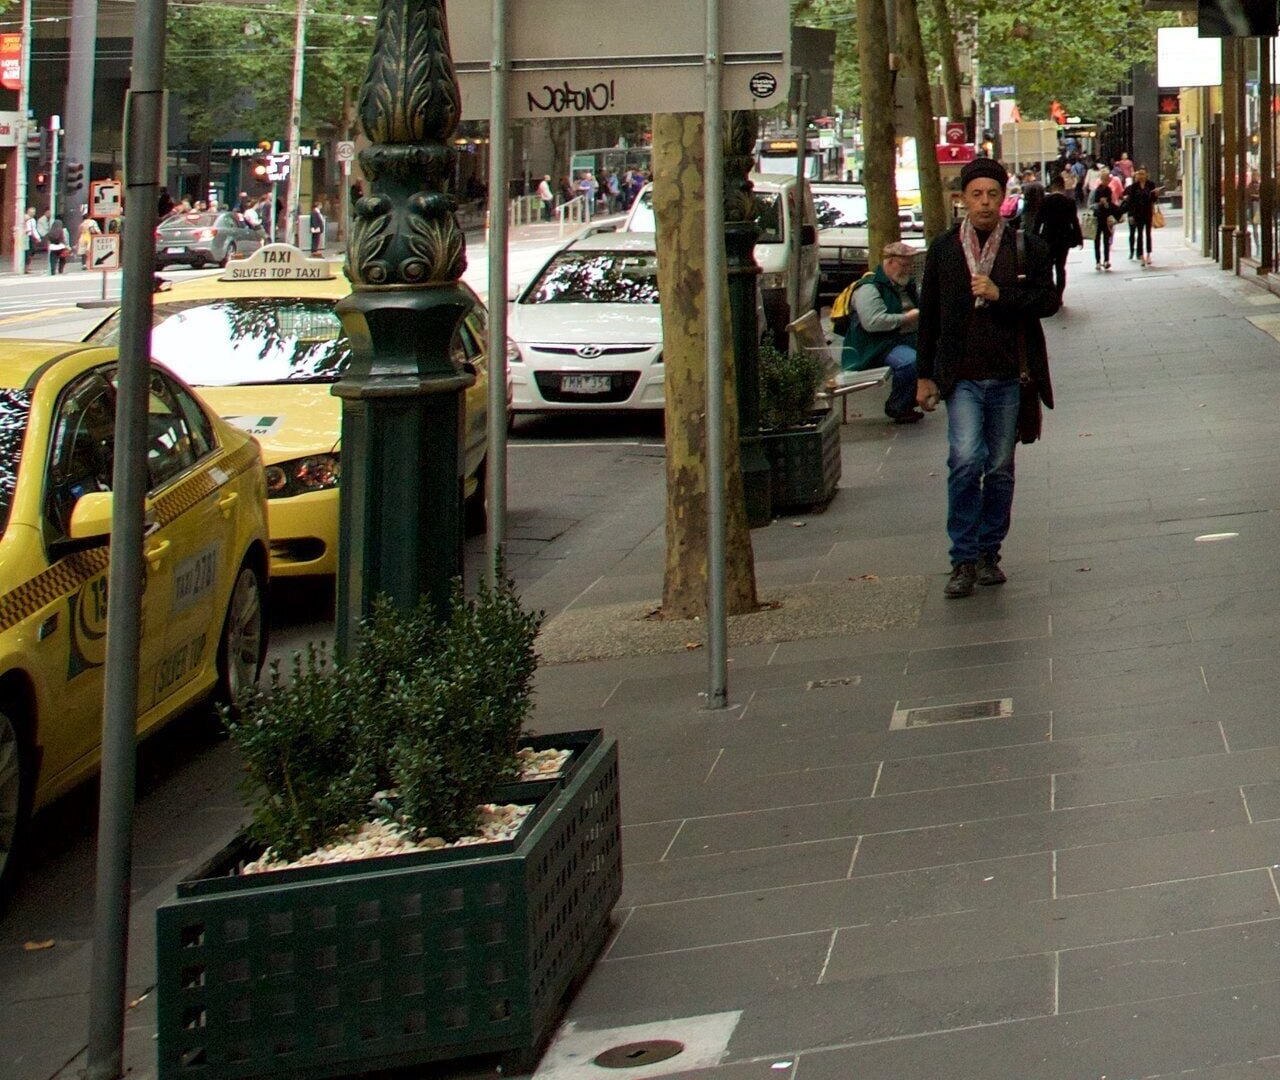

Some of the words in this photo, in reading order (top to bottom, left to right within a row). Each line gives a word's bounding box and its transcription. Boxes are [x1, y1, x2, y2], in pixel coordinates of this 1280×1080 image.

[263, 251, 292, 263] TAXI
[232, 268, 267, 278] SILVER
[271, 267, 292, 278] TOP
[296, 267, 320, 278] TAXI
[158, 644, 188, 693] SILVER
